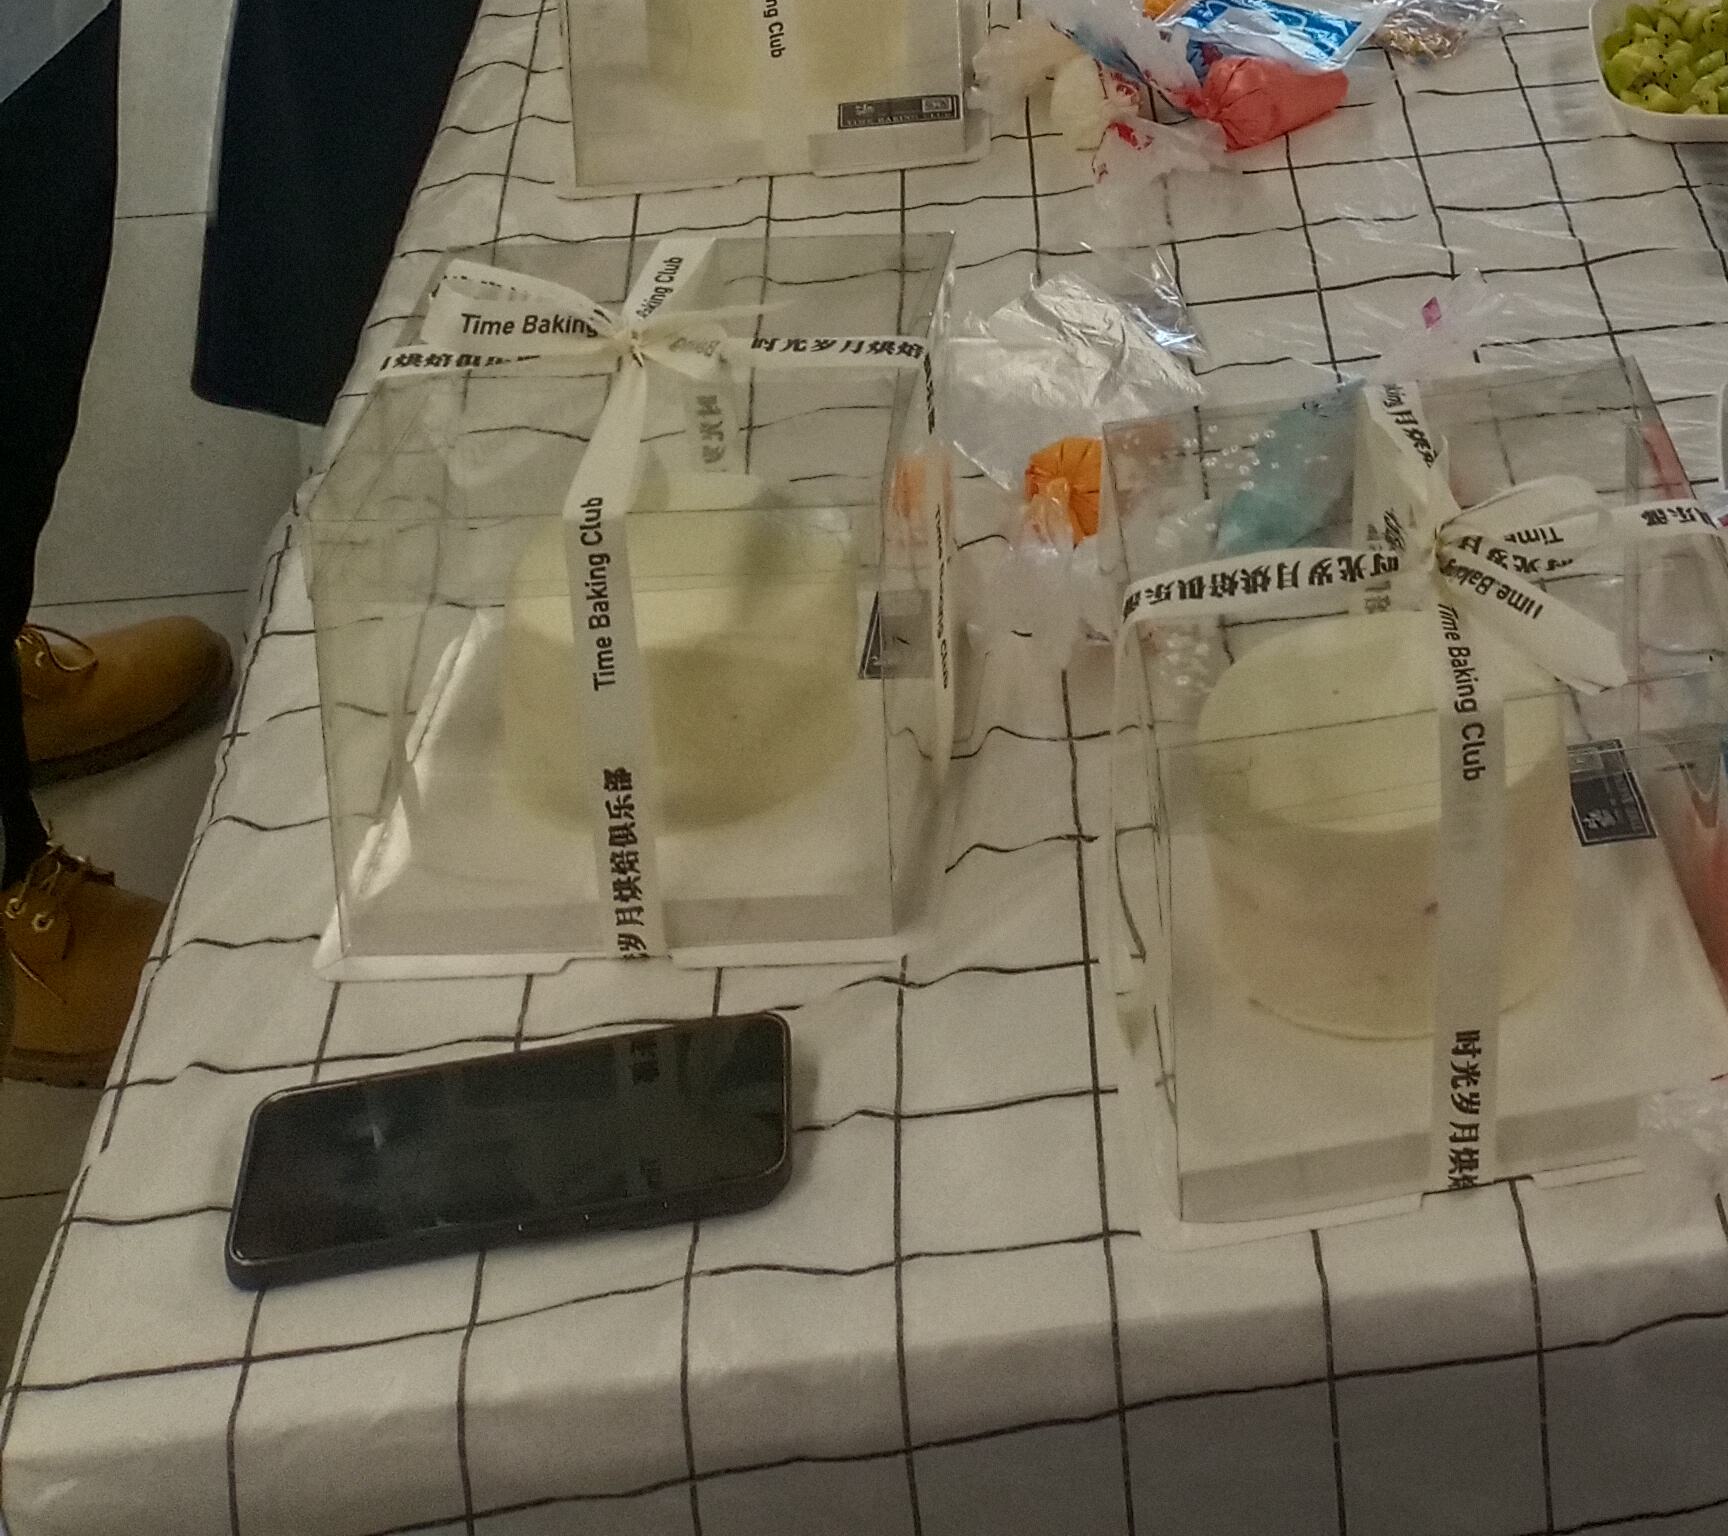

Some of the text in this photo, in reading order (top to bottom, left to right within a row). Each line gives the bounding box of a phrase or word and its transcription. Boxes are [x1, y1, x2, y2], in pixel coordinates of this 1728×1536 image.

[769, 21, 784, 59] Club
[654, 256, 683, 285] Club
[460, 312, 599, 339] Time Baking
[580, 496, 617, 691] Time Baking Club
[1122, 551, 1400, 624] 时光岁月烘焙俱乐部
[1437, 602, 1487, 782] Time Baking Club
